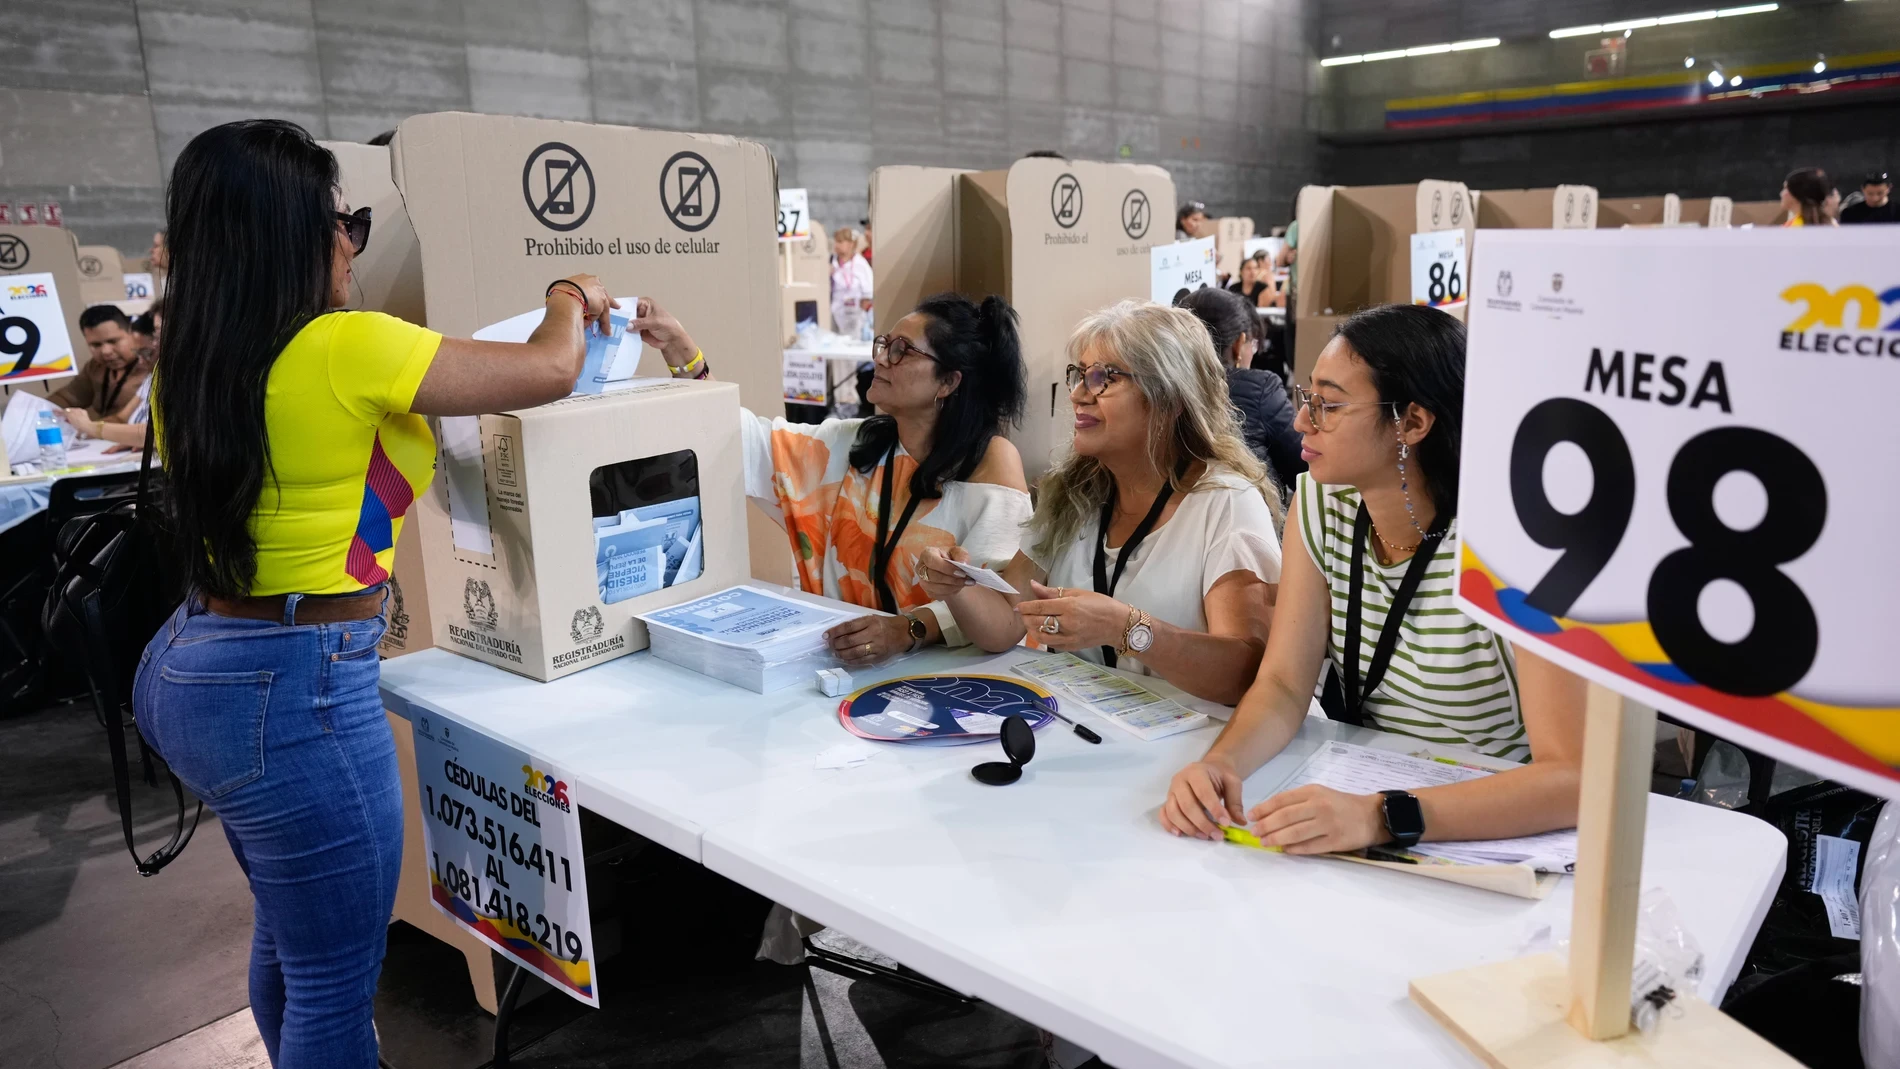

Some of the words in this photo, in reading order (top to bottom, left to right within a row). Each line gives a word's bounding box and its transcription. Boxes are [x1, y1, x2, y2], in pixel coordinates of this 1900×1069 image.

[524, 237, 604, 256] Prohibido
[608, 237, 622, 255] el
[625, 243, 651, 255] uso
[654, 237, 671, 254] de
[675, 237, 720, 254] celular
[1044, 232, 1080, 245] Prohibido
[1081, 233, 1089, 244] el
[1116, 247, 1128, 256] uso
[1130, 244, 1139, 255] de
[8, 284, 47, 296] 2026
[125, 283, 147, 298] 90
[1184, 269, 1202, 285] MESA
[1428, 260, 1461, 303] 86
[1583, 346, 1732, 414] MESA
[1509, 397, 1828, 698] 98
[607, 572, 647, 589] PRESID
[655, 591, 743, 618] COLOMBIA
[449, 624, 522, 656] REGISTRADURÍA
[450, 636, 475, 649] NACIONAL
[475, 643, 486, 652] DEL
[487, 646, 508, 660] ESTADO
[508, 654, 523, 664] CIVIL
[552, 634, 625, 664] REGISTRADURÍA
[553, 658, 579, 670] NACIONAL
[580, 654, 591, 662] DEL
[591, 647, 612, 657] ESTADO
[611, 643, 625, 651] CIVIL
[444, 757, 508, 811] CÉDULAS
[510, 791, 541, 829] DEL
[521, 764, 570, 807] 2026
[524, 784, 571, 814] ELECCIONES
[426, 784, 573, 893] 1.073.516.411
[485, 853, 510, 890] AL
[432, 851, 583, 965] 1.081.418.219
